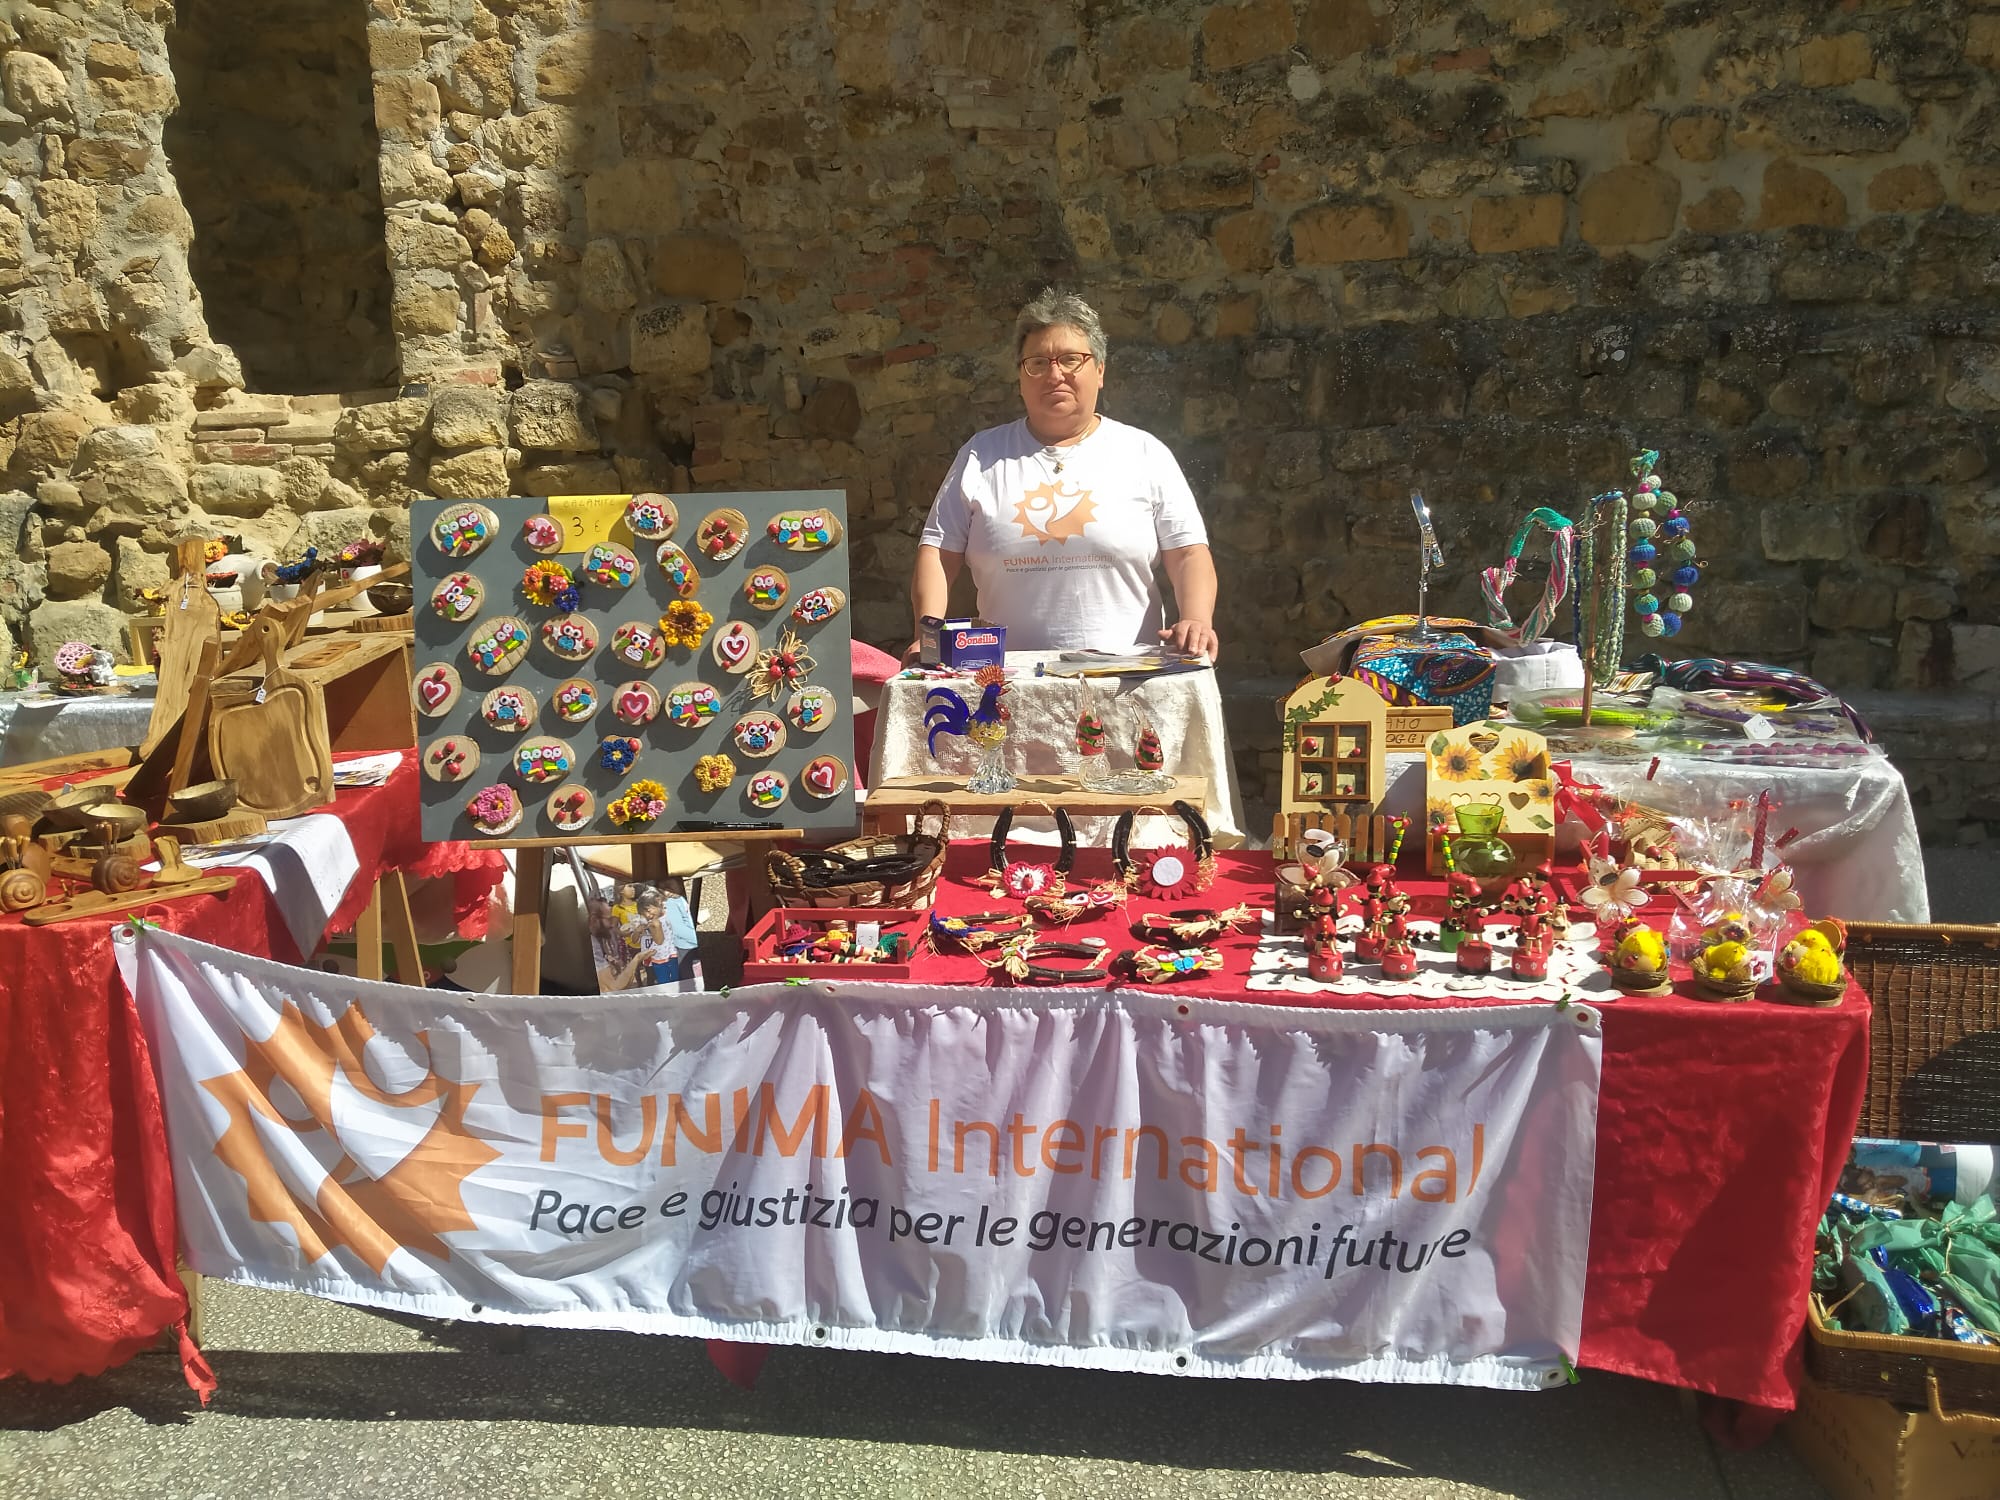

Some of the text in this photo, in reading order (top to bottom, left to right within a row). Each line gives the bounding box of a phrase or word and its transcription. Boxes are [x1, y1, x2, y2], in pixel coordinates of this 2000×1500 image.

[572, 516, 584, 537] 3
[1003, 555, 1049, 567] FUNIMA
[540, 1082, 1485, 1204] FUNIMA International
[529, 1182, 1472, 1280] Pace e giustizia per le generazioni future
